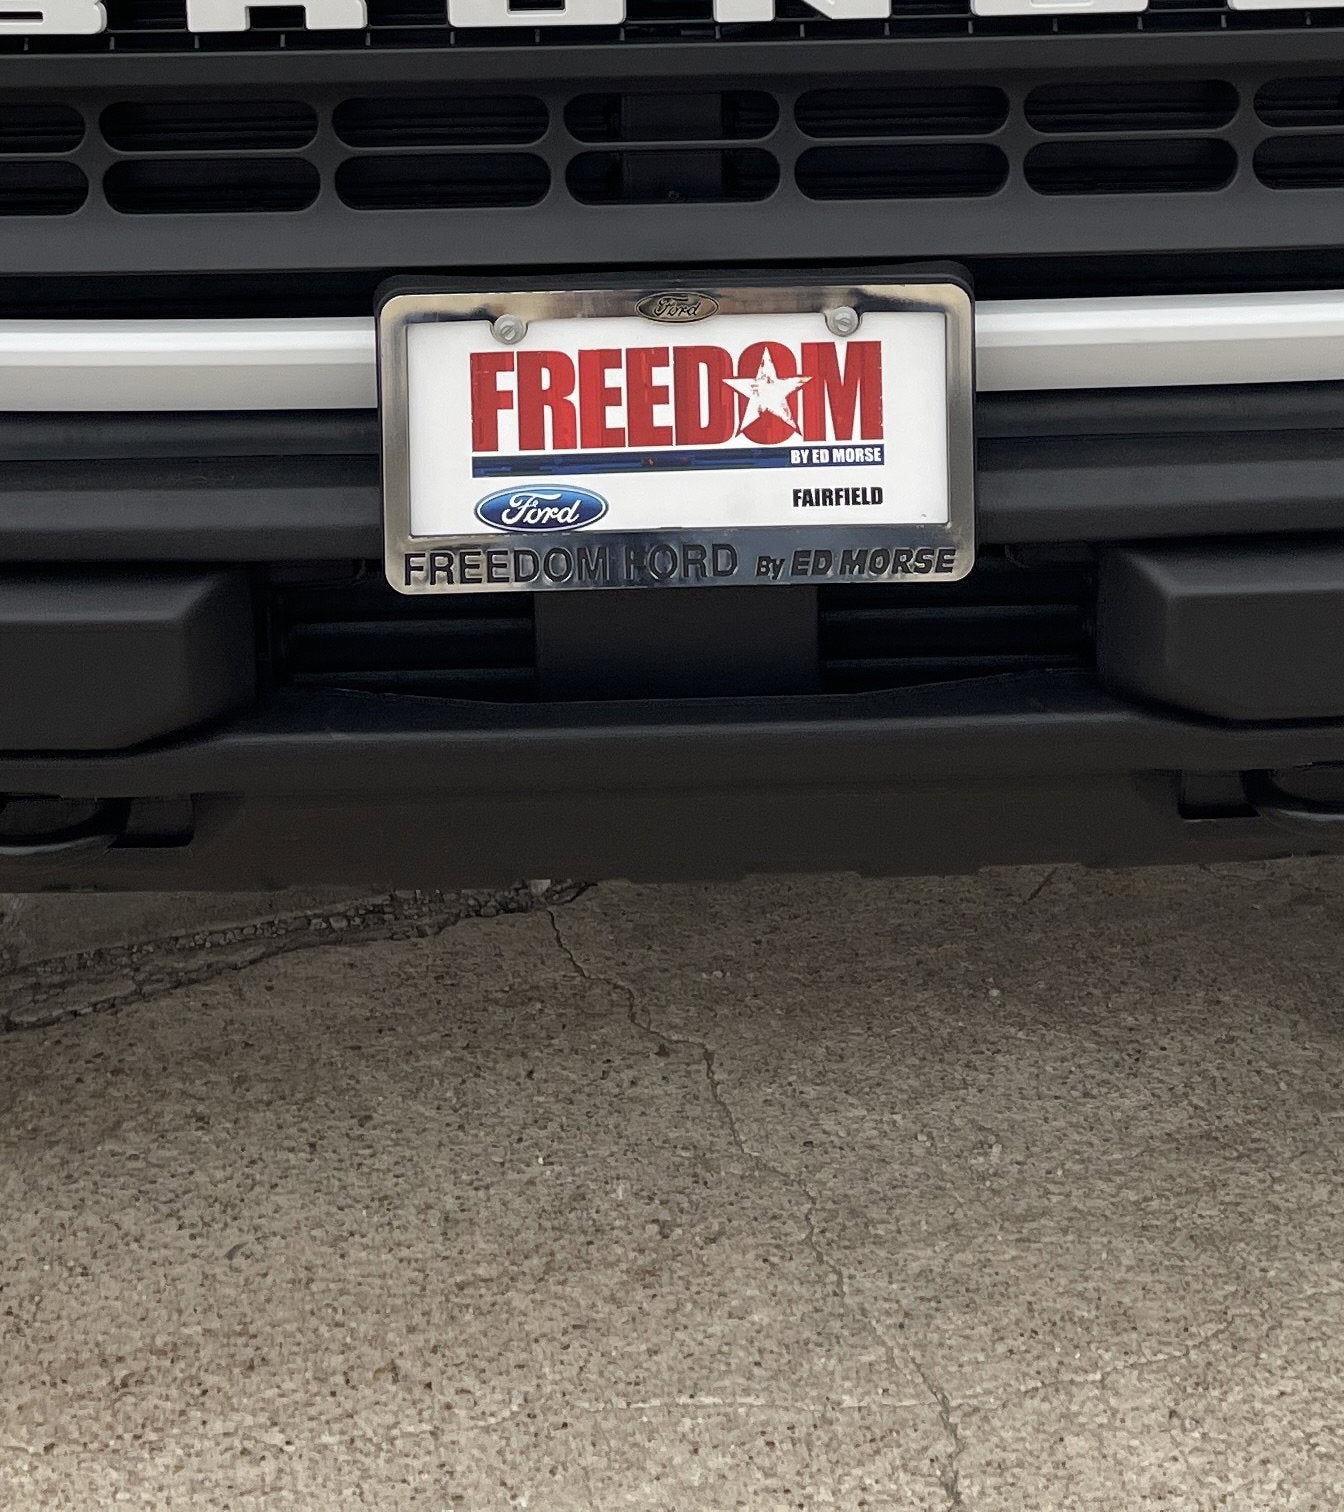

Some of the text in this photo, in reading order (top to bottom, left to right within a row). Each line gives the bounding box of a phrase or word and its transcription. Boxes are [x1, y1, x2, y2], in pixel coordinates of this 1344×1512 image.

[654, 295, 702, 317] Ford
[469, 340, 885, 453] FREEDOM
[790, 447, 882, 465] BY ED MORSE
[501, 492, 582, 525] Ford
[792, 486, 884, 508] FAIRFIELD
[404, 543, 957, 586] FREEDOM FORD By ED MORSE
